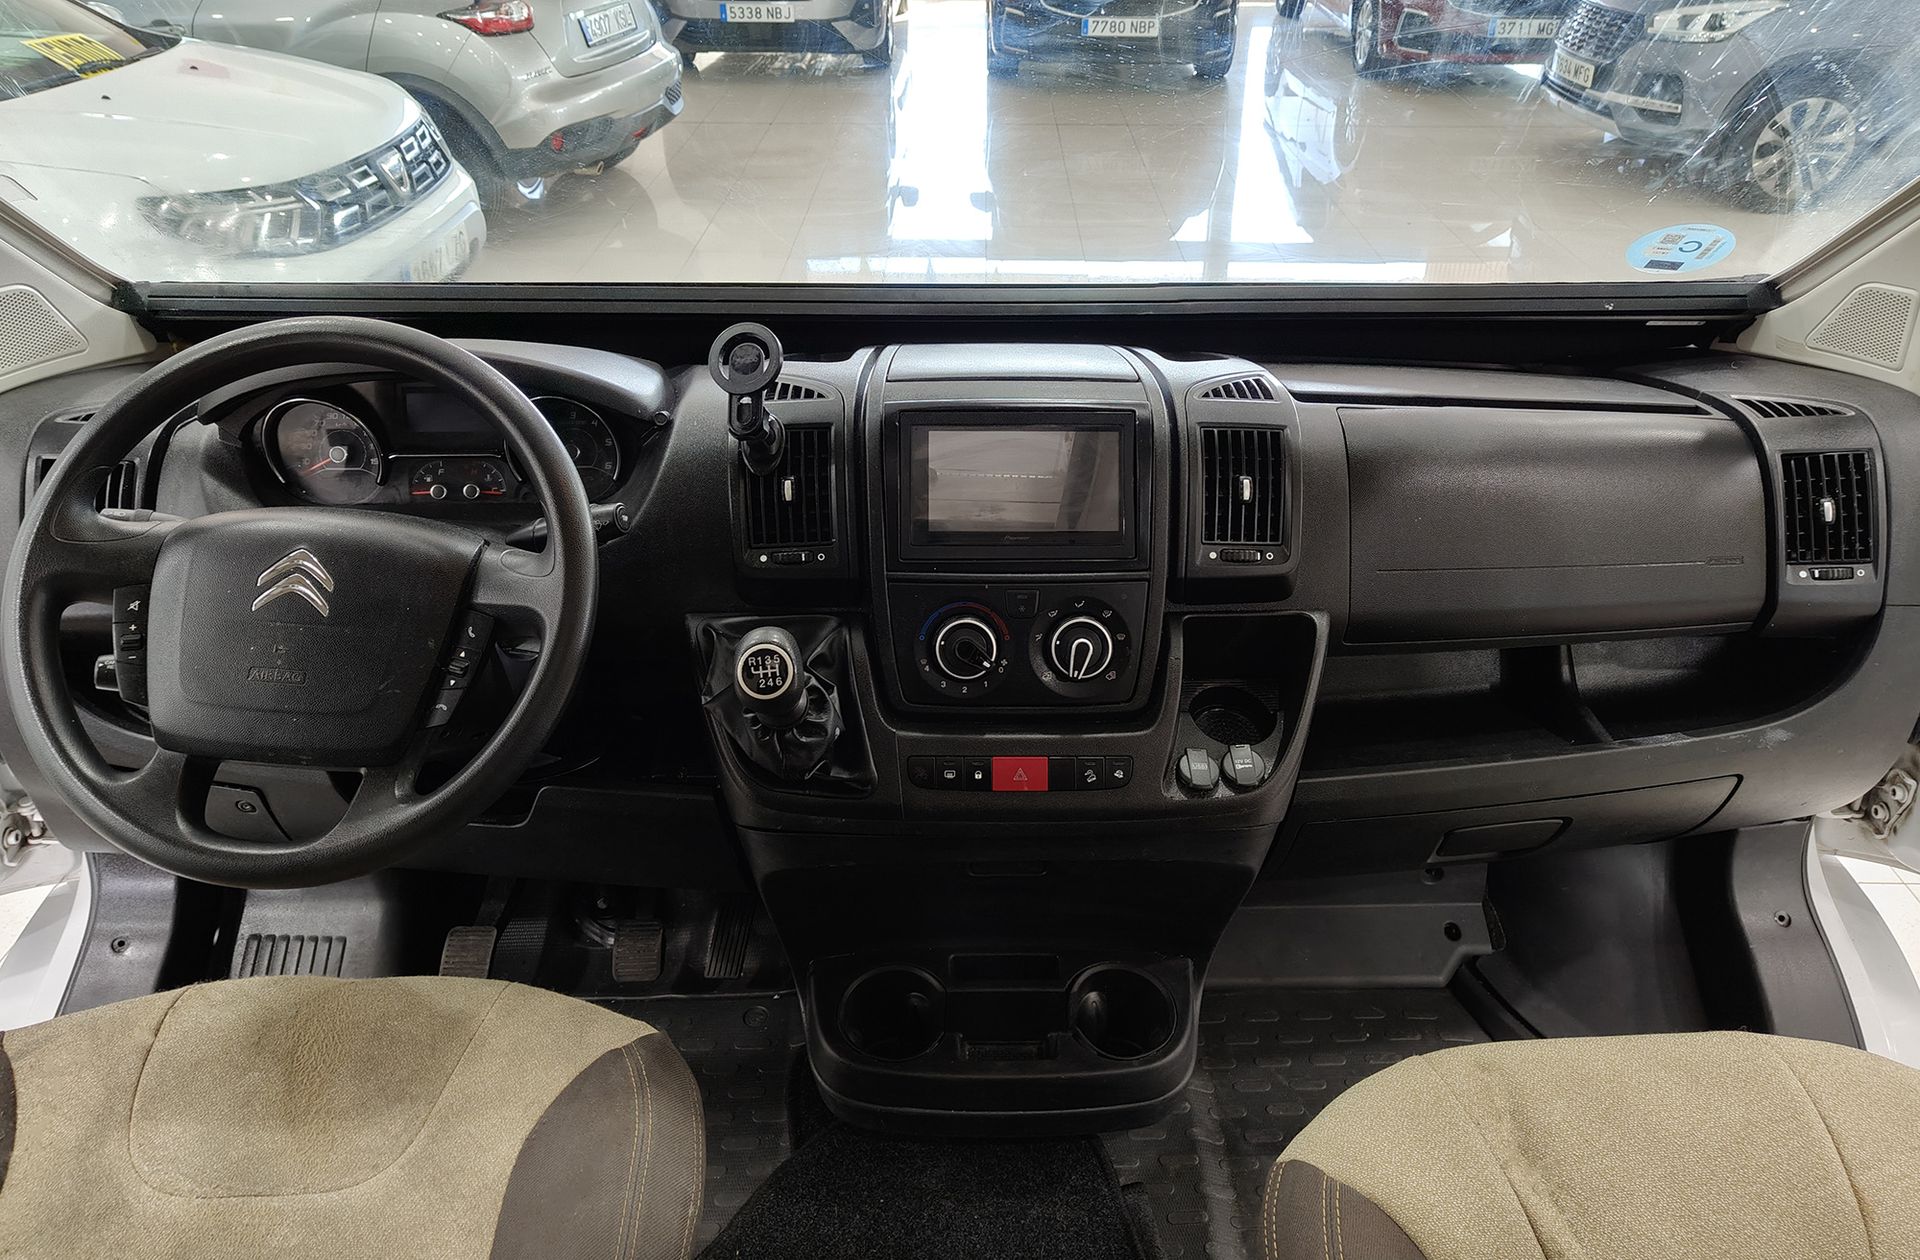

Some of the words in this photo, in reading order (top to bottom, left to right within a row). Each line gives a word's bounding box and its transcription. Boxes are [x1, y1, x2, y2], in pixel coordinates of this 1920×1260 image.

[729, 6, 763, 19] 5338
[766, 6, 791, 19] NBJ
[1091, 20, 1126, 33] 7780
[1130, 20, 1155, 34] NBP
[1497, 21, 1532, 35] 3711
[1678, 240, 1703, 253] C
